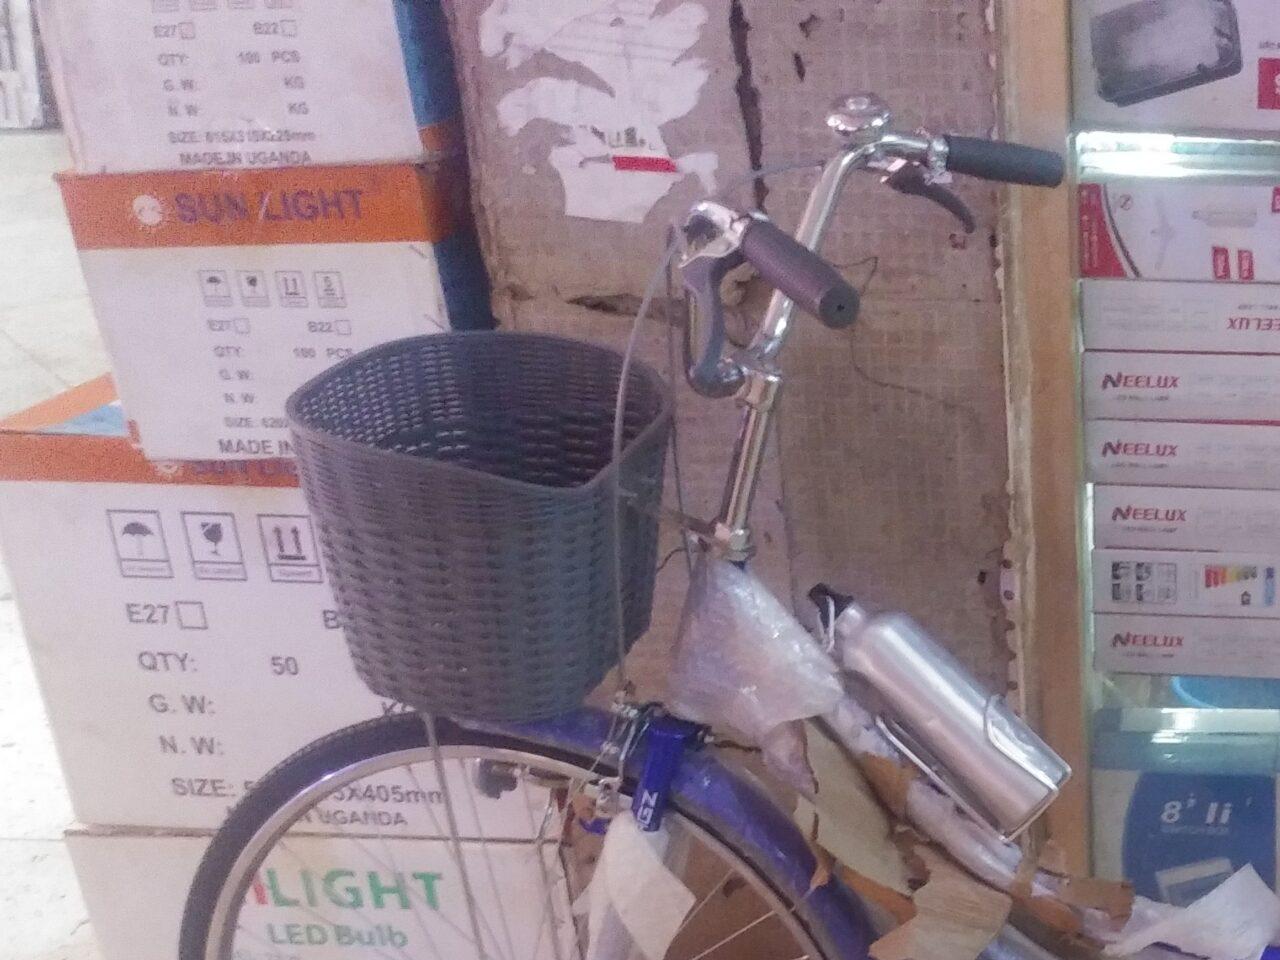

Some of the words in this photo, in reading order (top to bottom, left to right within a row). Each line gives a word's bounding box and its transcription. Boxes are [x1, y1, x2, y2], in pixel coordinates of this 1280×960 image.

[247, 150, 312, 165] UGANDA
[174, 191, 249, 225] SUN
[258, 187, 363, 222] LIGHT
[307, 321, 333, 333] B22
[1102, 372, 1180, 391] NEELUX
[219, 439, 275, 455] MADE
[1102, 440, 1178, 458] NEELUX
[1111, 505, 1187, 521] NEELUX
[125, 603, 172, 624] E27
[1111, 631, 1185, 648] NEELUX
[138, 652, 198, 673] QTY:
[271, 657, 299, 676] 50
[172, 778, 236, 798] SIZE:
[252, 868, 443, 911] LIGHT
[266, 922, 329, 945] LED
[334, 924, 409, 949] Bulb
